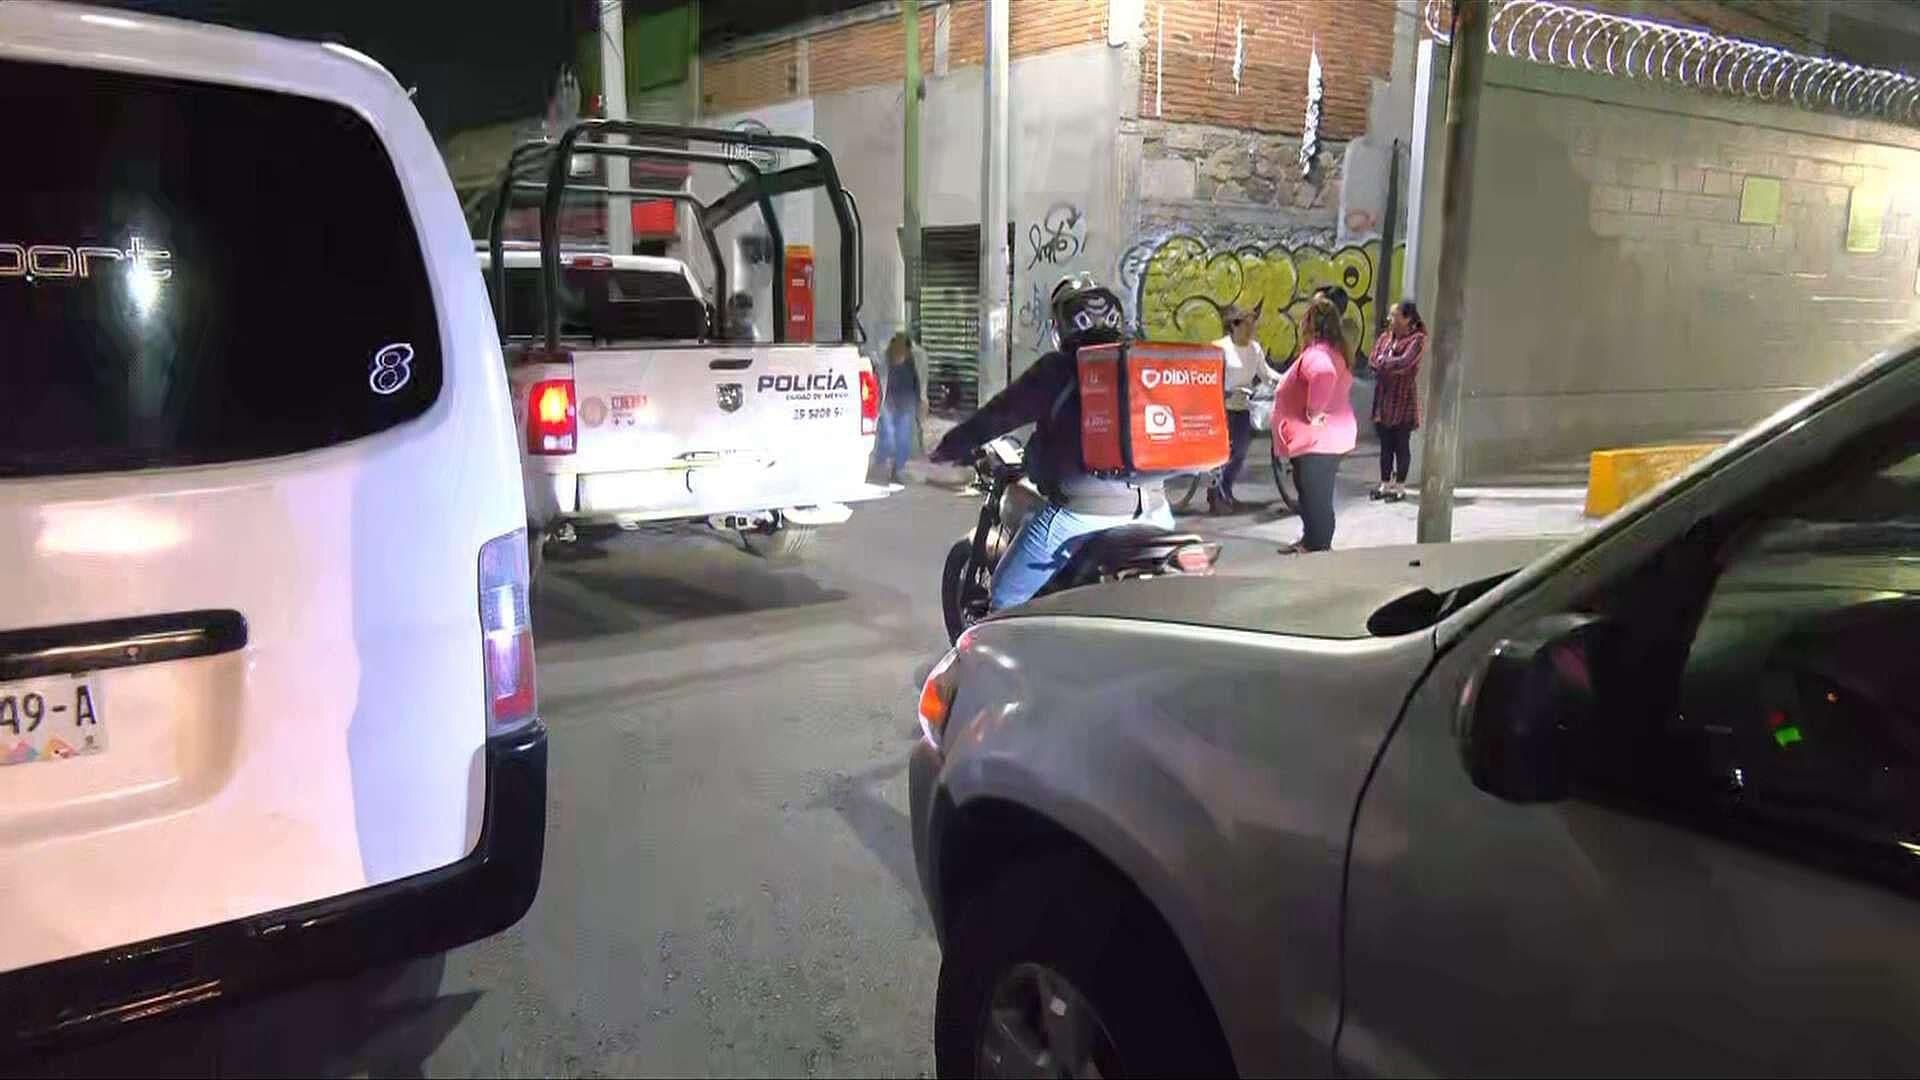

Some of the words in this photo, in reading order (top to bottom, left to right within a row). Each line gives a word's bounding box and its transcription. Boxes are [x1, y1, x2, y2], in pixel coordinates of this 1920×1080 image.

[369, 343, 414, 395] 8
[757, 368, 848, 393] POLICÍA
[1190, 369, 1217, 385] Food
